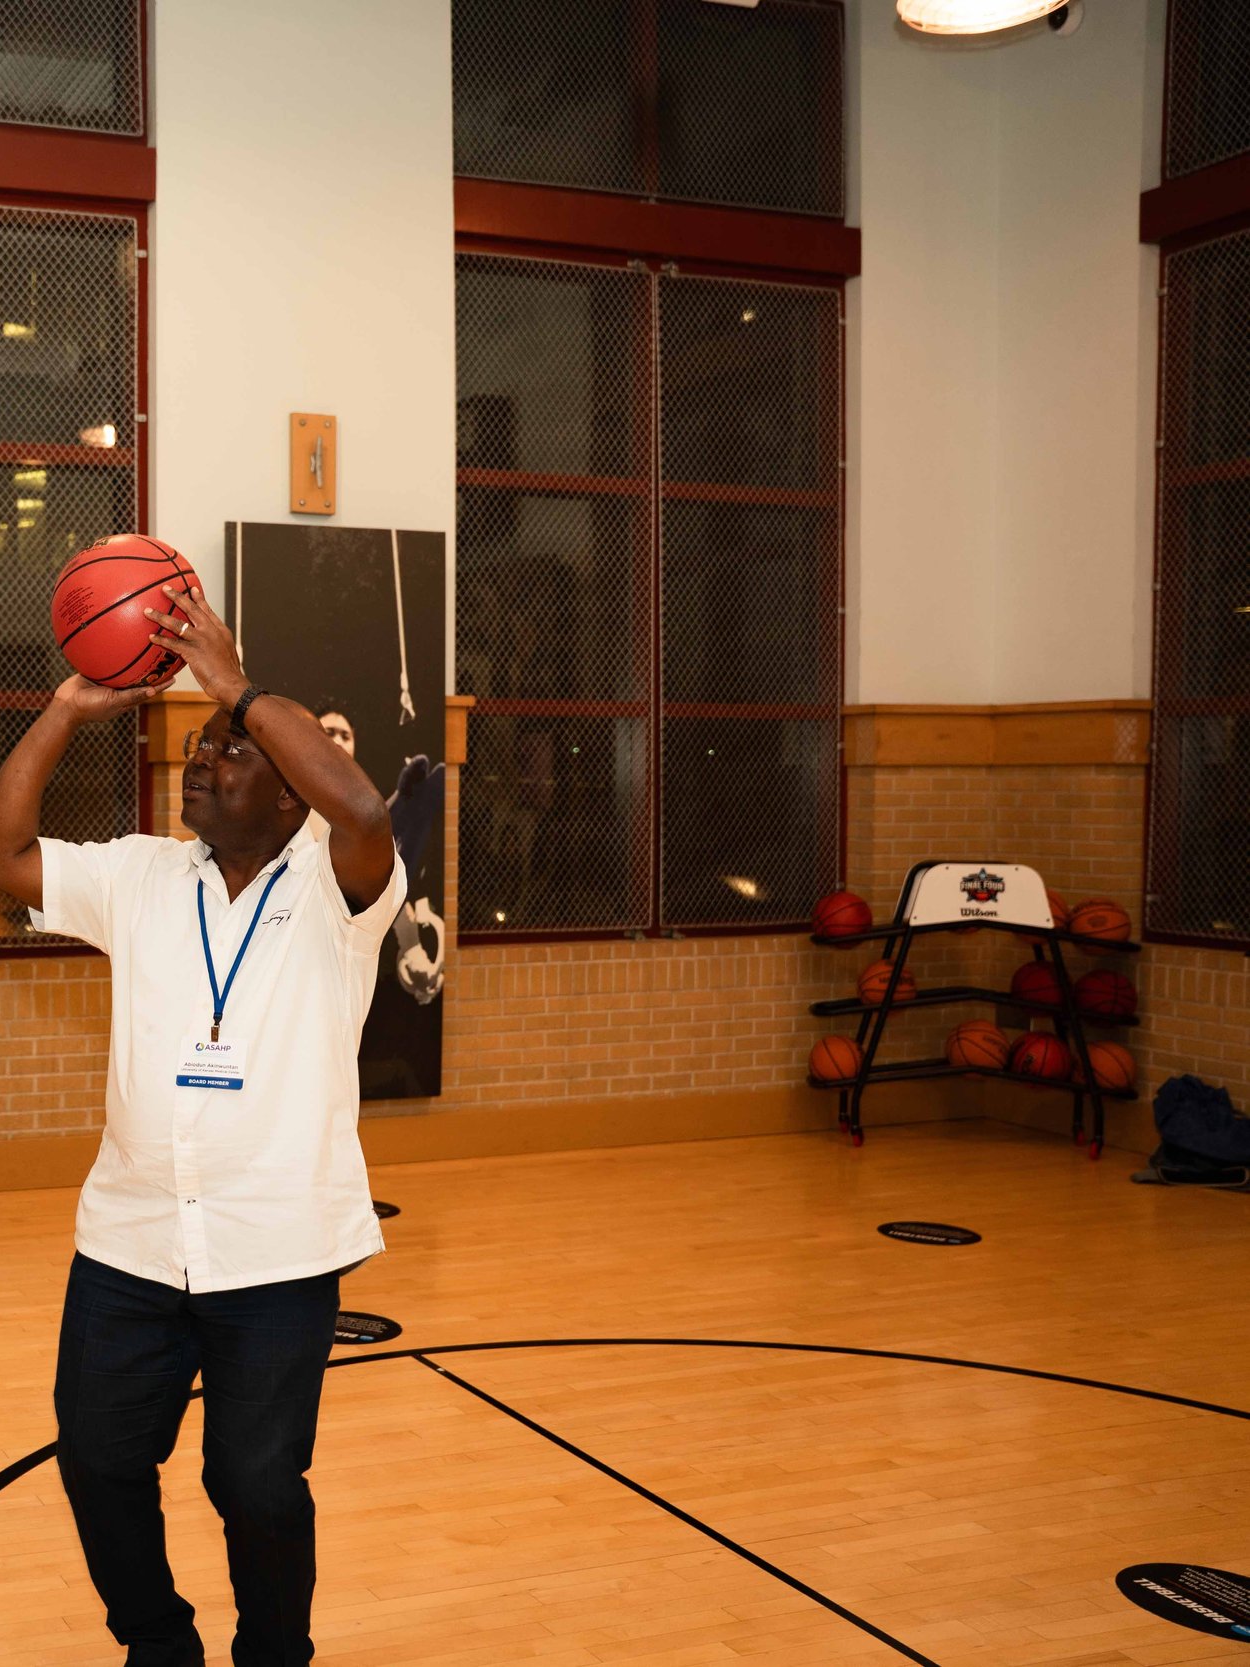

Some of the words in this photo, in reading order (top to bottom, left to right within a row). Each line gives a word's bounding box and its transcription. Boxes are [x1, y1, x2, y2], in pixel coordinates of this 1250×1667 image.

[961, 881, 981, 891] FINAL
[984, 881, 1004, 891] FOUR
[961, 908, 997, 917] Wilson
[1133, 1578, 1235, 1623] BASKETBALL
